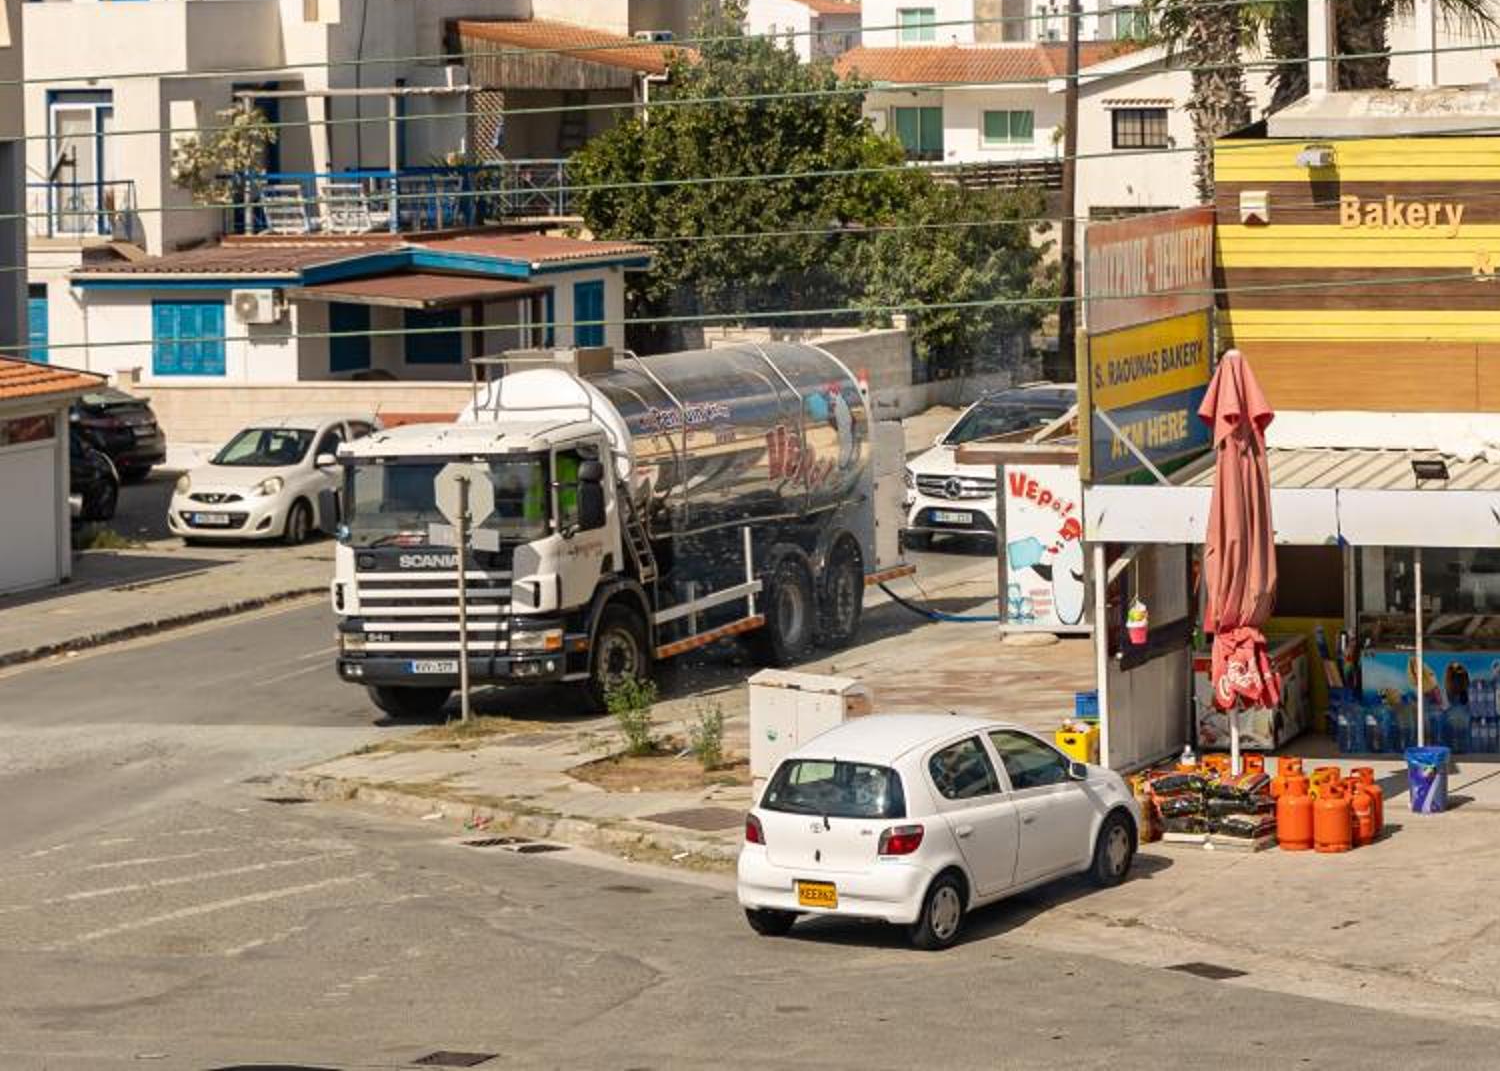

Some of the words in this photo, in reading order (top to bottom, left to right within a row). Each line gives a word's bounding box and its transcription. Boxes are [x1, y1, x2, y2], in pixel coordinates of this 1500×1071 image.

[1339, 195, 1465, 238] Bakery
[1471, 249, 1495, 281] &
[1161, 339, 1203, 371] BAKERY
[1148, 409, 1189, 447] HERE
[400, 554, 461, 569] SCANIA
